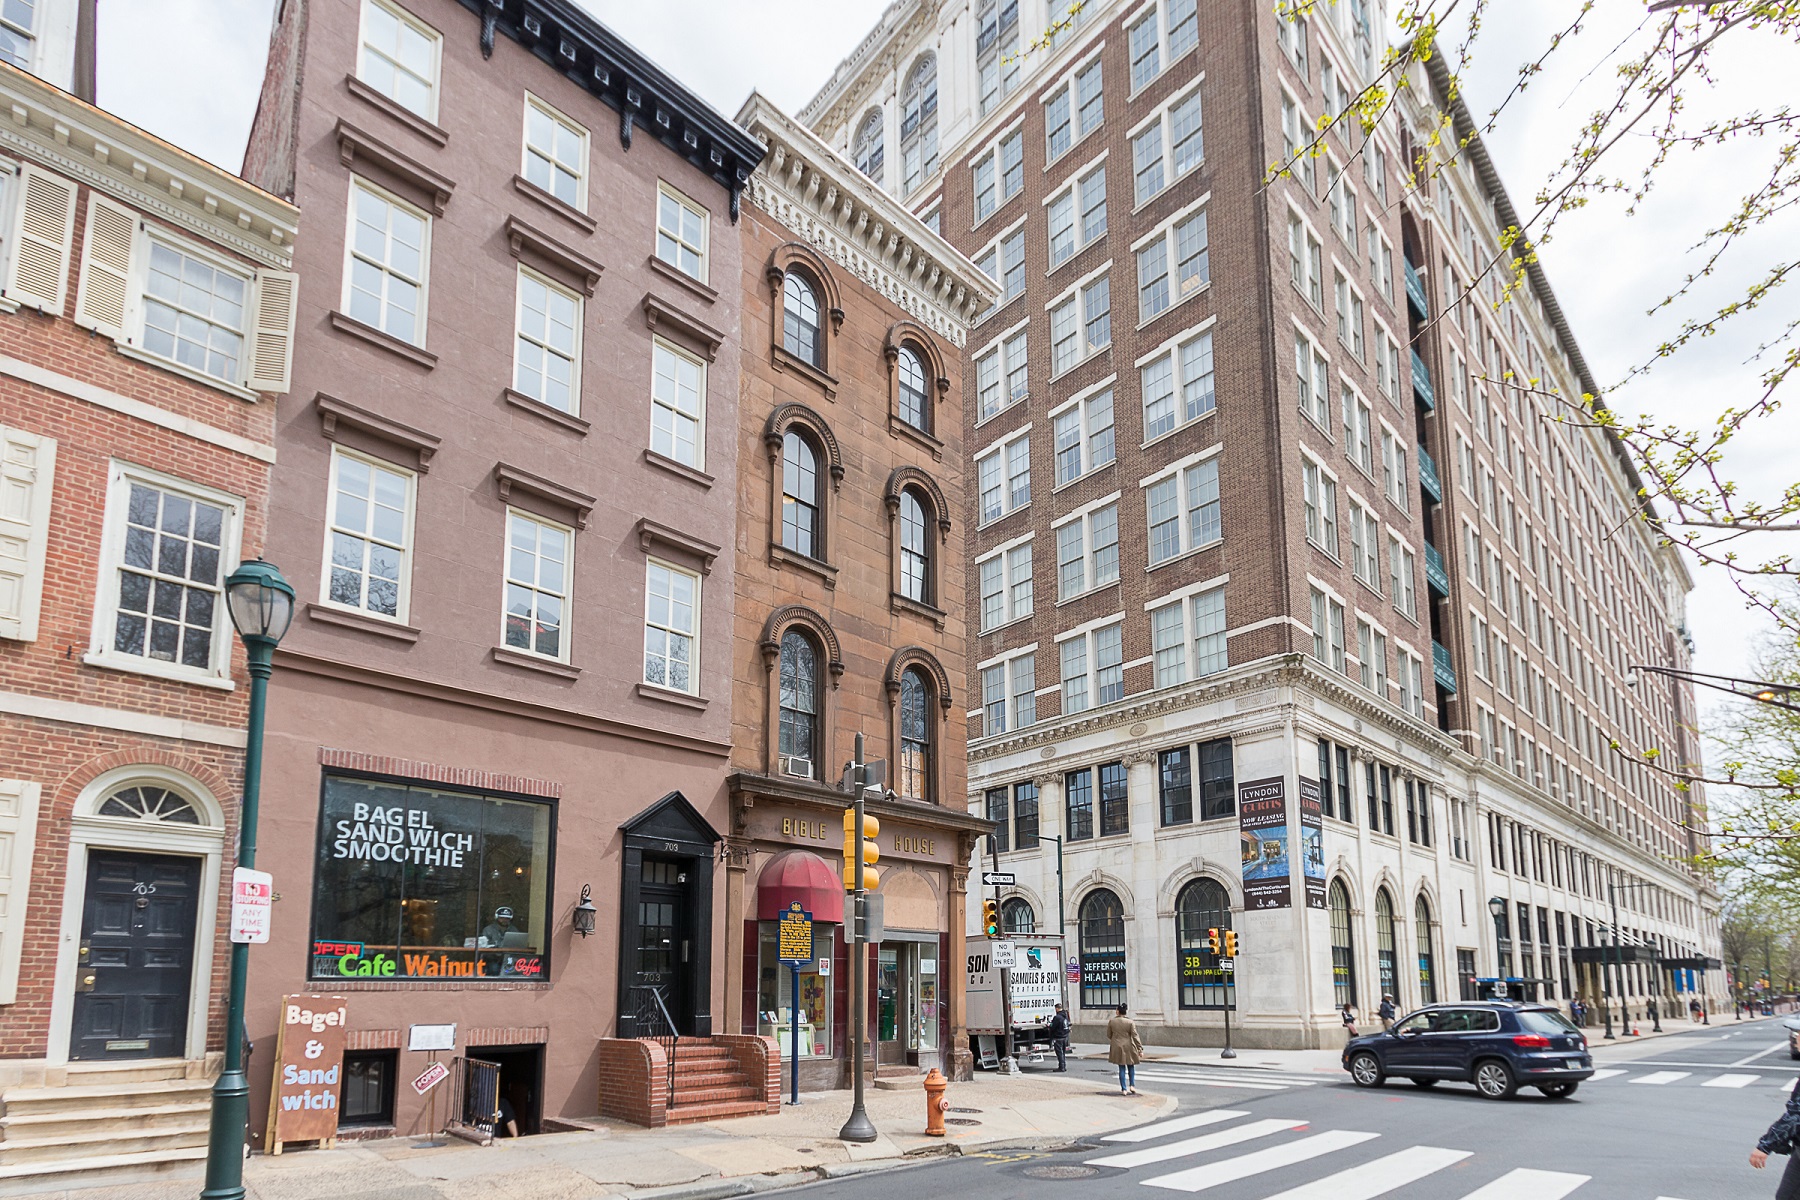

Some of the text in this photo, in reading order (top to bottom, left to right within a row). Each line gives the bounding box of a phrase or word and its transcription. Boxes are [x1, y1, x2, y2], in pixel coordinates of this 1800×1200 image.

[1244, 786, 1279, 799] LYNDON
[1242, 799, 1282, 814] CURTIS
[353, 802, 434, 829] BAGEL
[1242, 813, 1285, 824] NOW LEASING
[336, 820, 472, 852] SANDWICH
[782, 817, 935, 855] BIBLE HOUSE
[333, 840, 464, 868] SMOOTHIE
[664, 842, 679, 852] 703
[132, 882, 156, 895] 705
[245, 883, 261, 896] NO
[236, 894, 269, 906] STOPPING
[241, 909, 262, 917] ANY
[240, 918, 263, 927] TIME
[338, 953, 486, 977] Cafe Walnut
[967, 954, 990, 973] SON
[1084, 961, 1126, 972] JEFFERSON
[1185, 956, 1200, 968] 3B
[643, 973, 661, 982] 703
[1010, 972, 1039, 985] SAMUELS
[1040, 972, 1046, 984] &
[1046, 971, 1059, 984] SON
[286, 1005, 346, 1033] Bagel
[304, 1039, 325, 1060] &
[283, 1064, 339, 1085] Sand
[281, 1089, 337, 1111] wich
